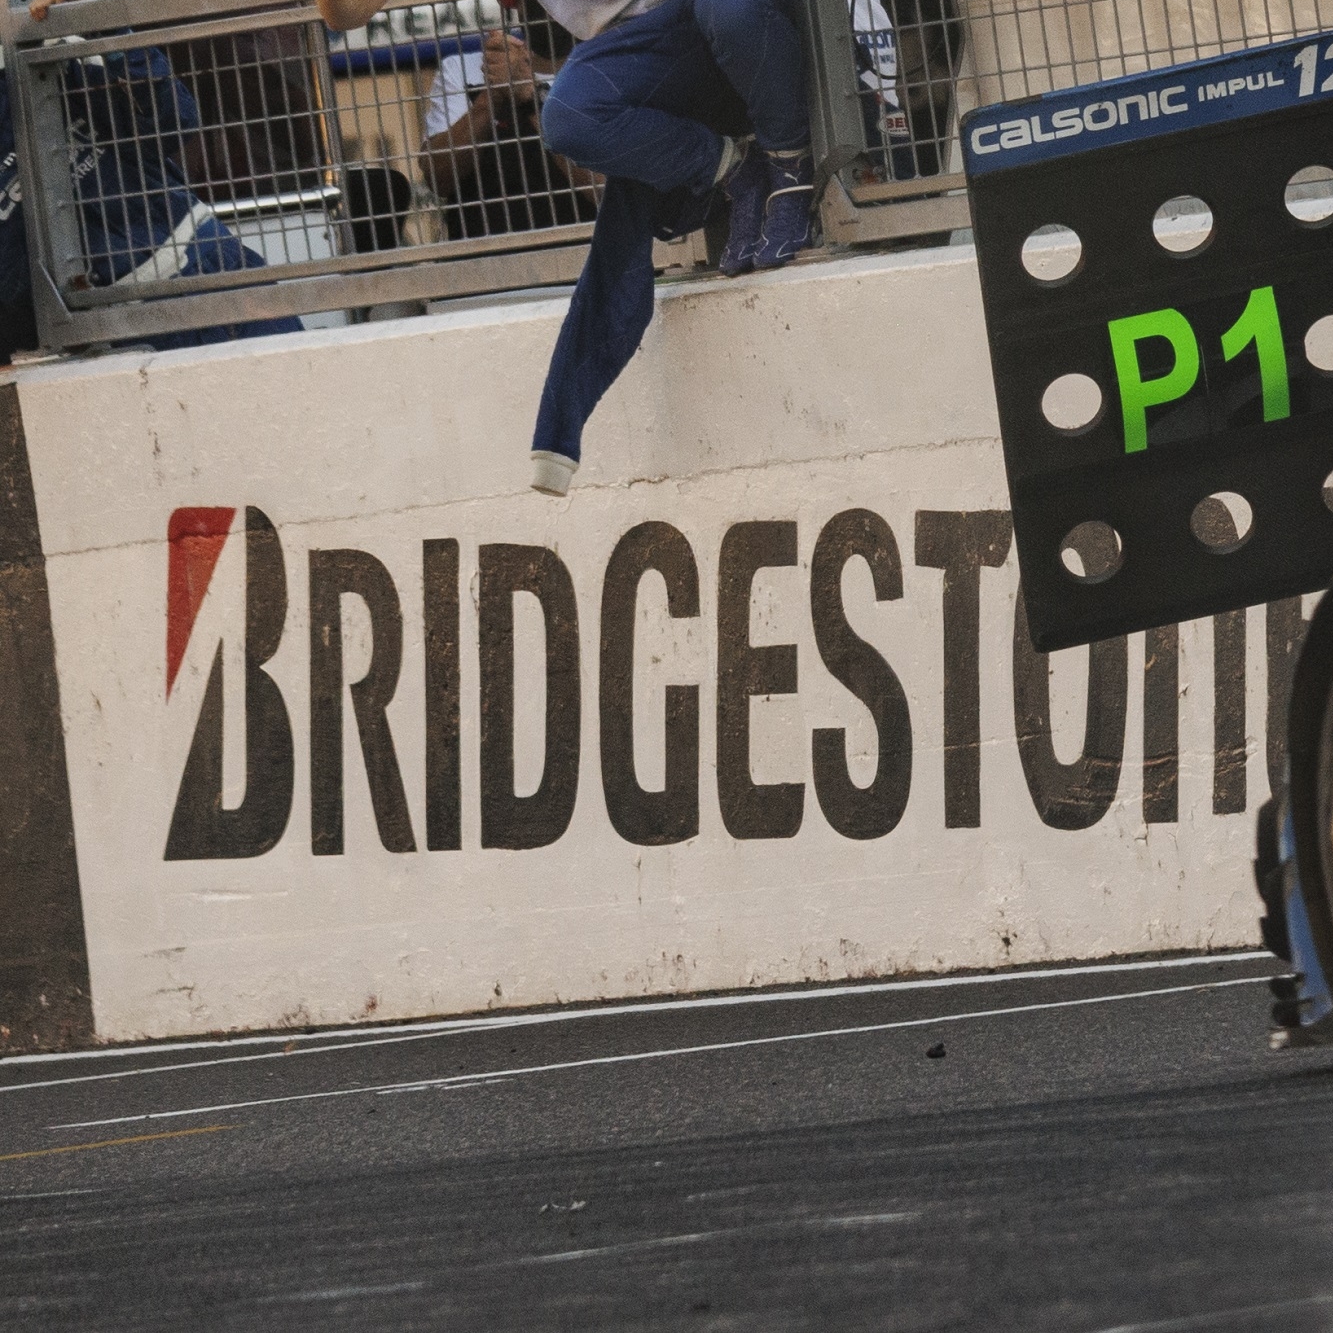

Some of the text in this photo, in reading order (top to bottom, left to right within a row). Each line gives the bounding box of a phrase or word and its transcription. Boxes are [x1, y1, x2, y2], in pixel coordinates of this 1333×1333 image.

[970, 84, 1189, 156] CALSONIC
[1198, 70, 1285, 103] IMPUL
[1106, 285, 1292, 454] P1
